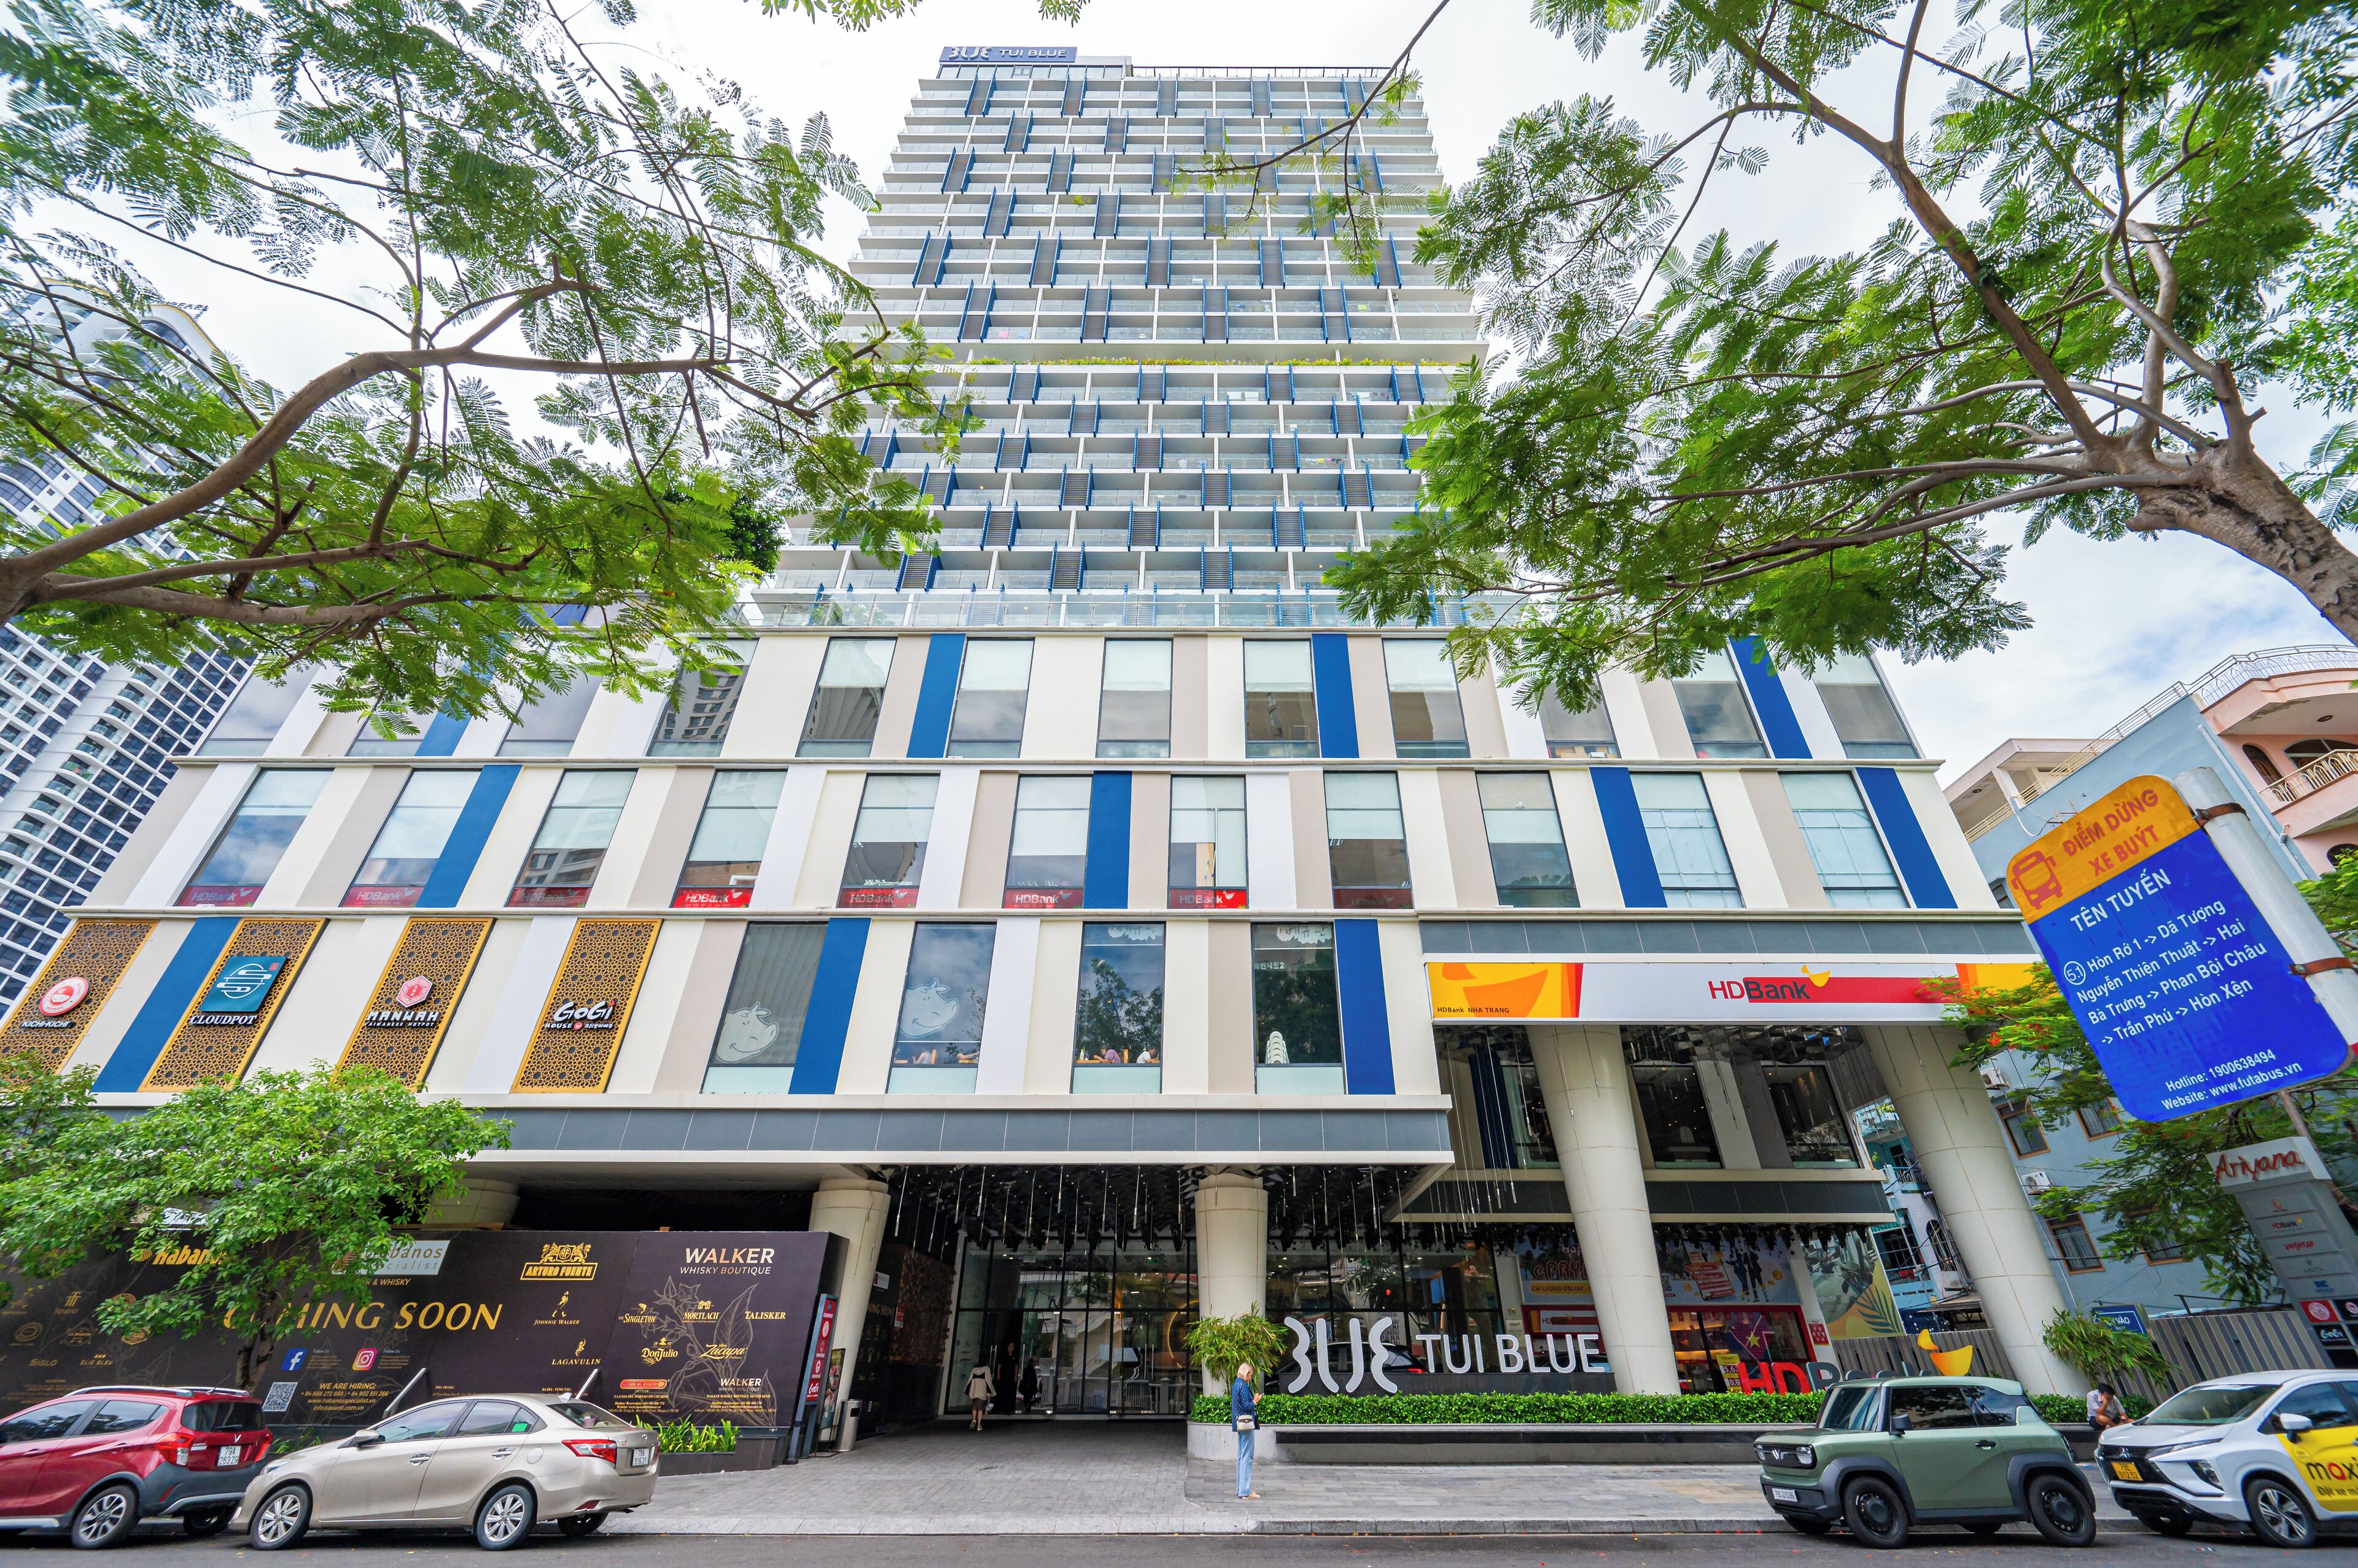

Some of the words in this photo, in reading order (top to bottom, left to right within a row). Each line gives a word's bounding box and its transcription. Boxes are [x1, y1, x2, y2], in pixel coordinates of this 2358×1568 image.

[1000, 49, 1024, 58] TUI
[1028, 49, 1067, 58] BLUE
[2062, 821, 2106, 857] ĐIỂM
[2103, 790, 2158, 831] DỪNG
[2088, 852, 2115, 877] XE
[2113, 825, 2159, 863] BUÝT
[357, 891, 400, 900] HDBank
[850, 894, 894, 903] HDBank
[1015, 895, 1059, 904] HDBank
[1180, 895, 1223, 904] HDBank
[2070, 903, 2108, 931] TÊN
[2106, 868, 2171, 912] TUYẾN
[2087, 955, 2113, 972] Hòn
[2112, 943, 2132, 960] Rớ
[2133, 938, 2142, 950] 1
[2157, 920, 2179, 938] Dã
[2177, 901, 2226, 927] Tượng
[2077, 976, 2123, 1003] Nguyễn
[2122, 961, 2160, 982] Thiện
[2159, 940, 2201, 965] Thuật
[2217, 918, 2245, 940] Hai
[1708, 980, 1811, 999] HDBank
[2088, 1009, 2107, 1025] Bà
[2106, 995, 2146, 1016] Trưng
[2159, 972, 2198, 994] Phan
[2196, 958, 2224, 979] Bội
[2224, 943, 2267, 966] Châu
[367, 1011, 440, 1021] MANWAH
[2113, 1020, 2145, 1039] Trần
[2144, 1007, 2174, 1028] Phú
[2189, 992, 2221, 1011] Hòn
[2219, 979, 2253, 999] Xện
[190, 1015, 257, 1025] CLOUDPOT
[2165, 1073, 2208, 1092] Hotline:
[2209, 1049, 2276, 1077] 1900638494
[2162, 1090, 2209, 1109] Website:
[2209, 1063, 2303, 1096] www.futabus.vn
[2216, 1149, 2304, 1181] Ariyana
[685, 1248, 775, 1263] WALKER
[525, 1266, 559, 1276] ARTURO
[559, 1266, 593, 1276] FUENTE
[720, 1267, 771, 1275] BOUTIQUE
[395, 1302, 502, 1330] SOON
[623, 1313, 656, 1323] SINGLETON
[700, 1344, 747, 1359] Zacapa
[1415, 1334, 1485, 1373] TUI
[1496, 1334, 1605, 1373] BLUE
